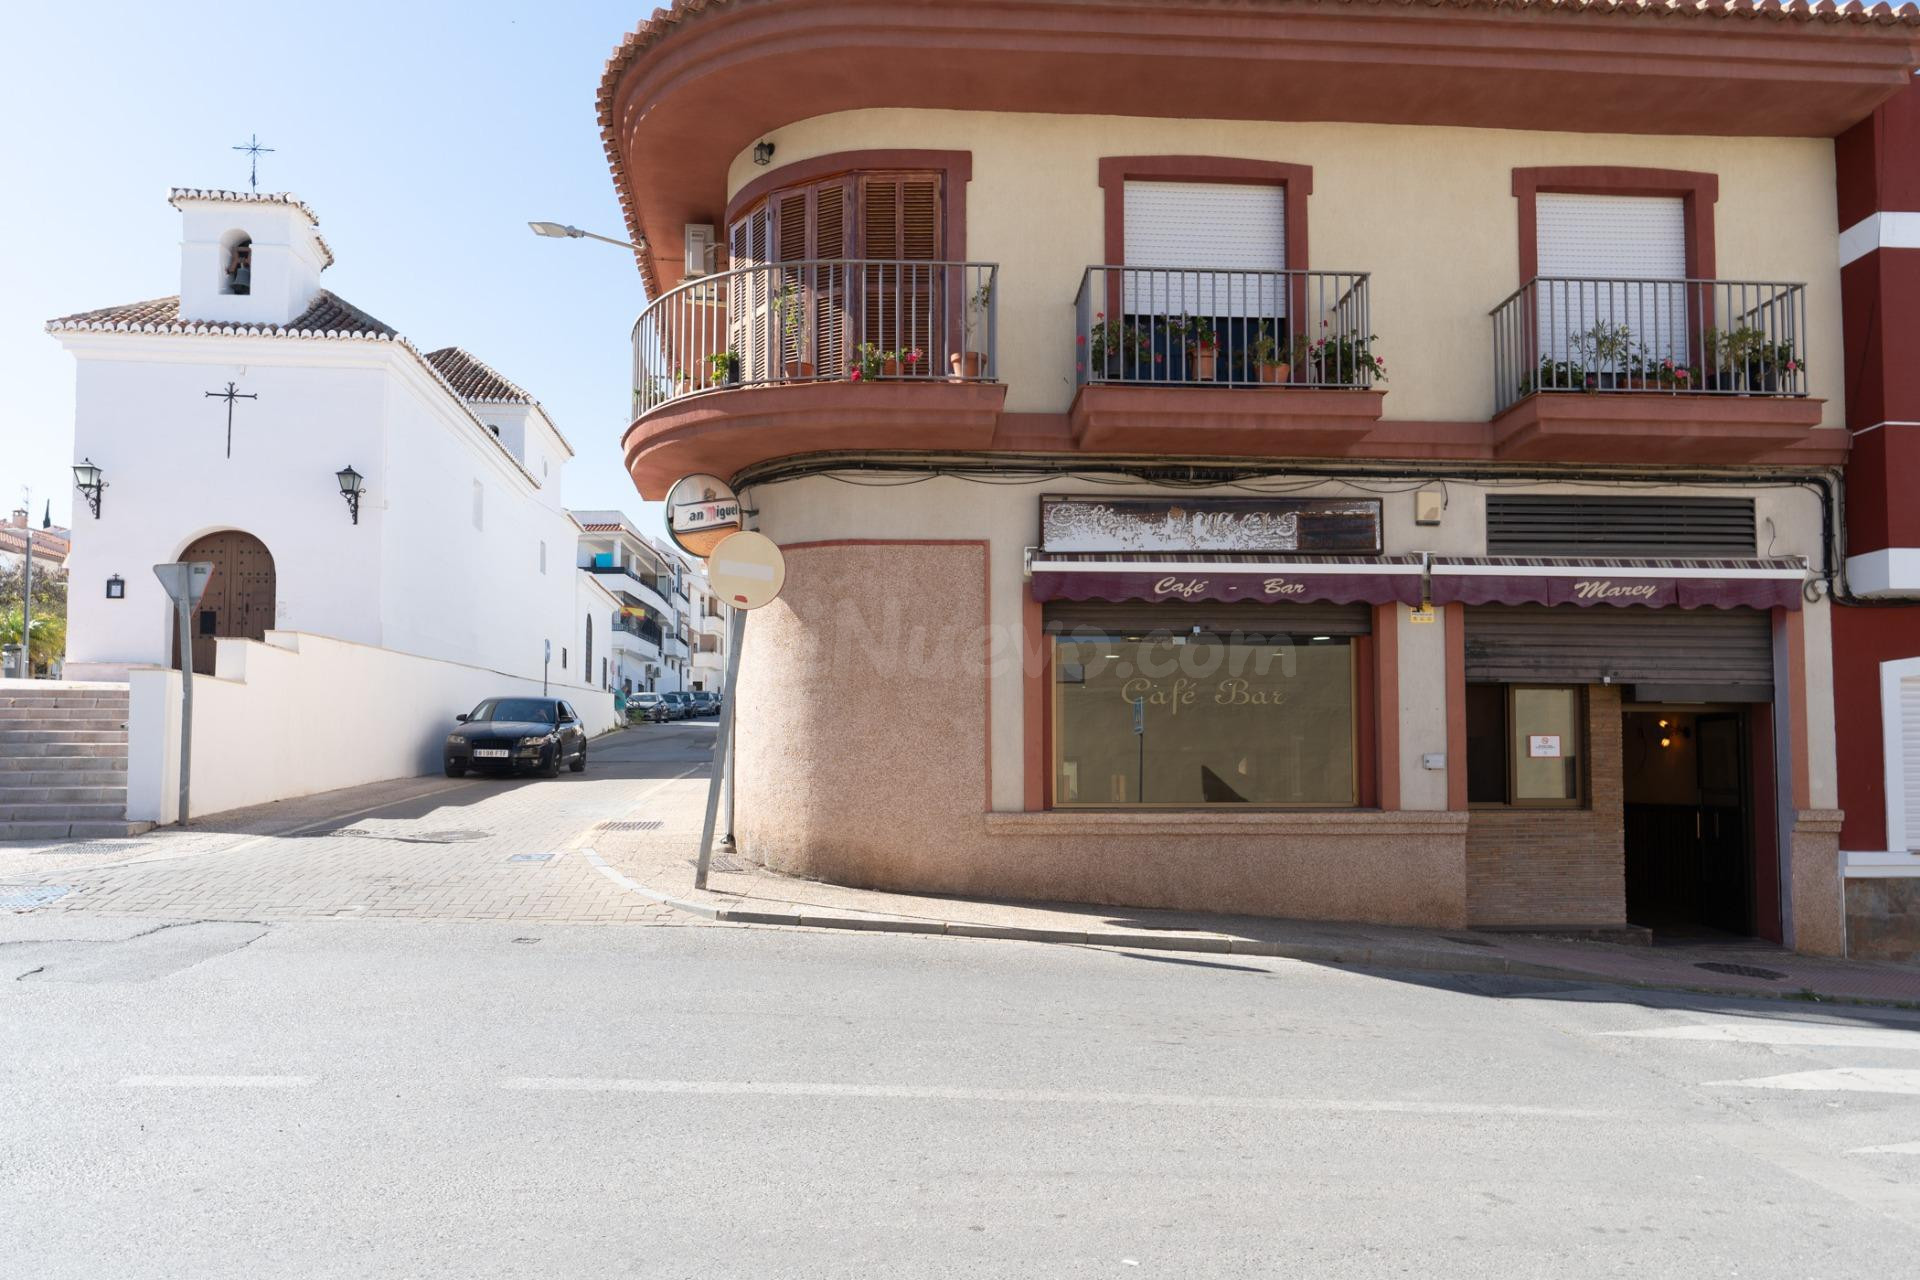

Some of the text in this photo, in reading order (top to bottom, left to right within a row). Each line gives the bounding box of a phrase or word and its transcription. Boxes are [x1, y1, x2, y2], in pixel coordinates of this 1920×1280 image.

[1154, 576, 1209, 597] Café
[1263, 578, 1306, 594] Bar
[1574, 581, 1658, 600] Marey
[1121, 677, 1287, 715] Café Bar
